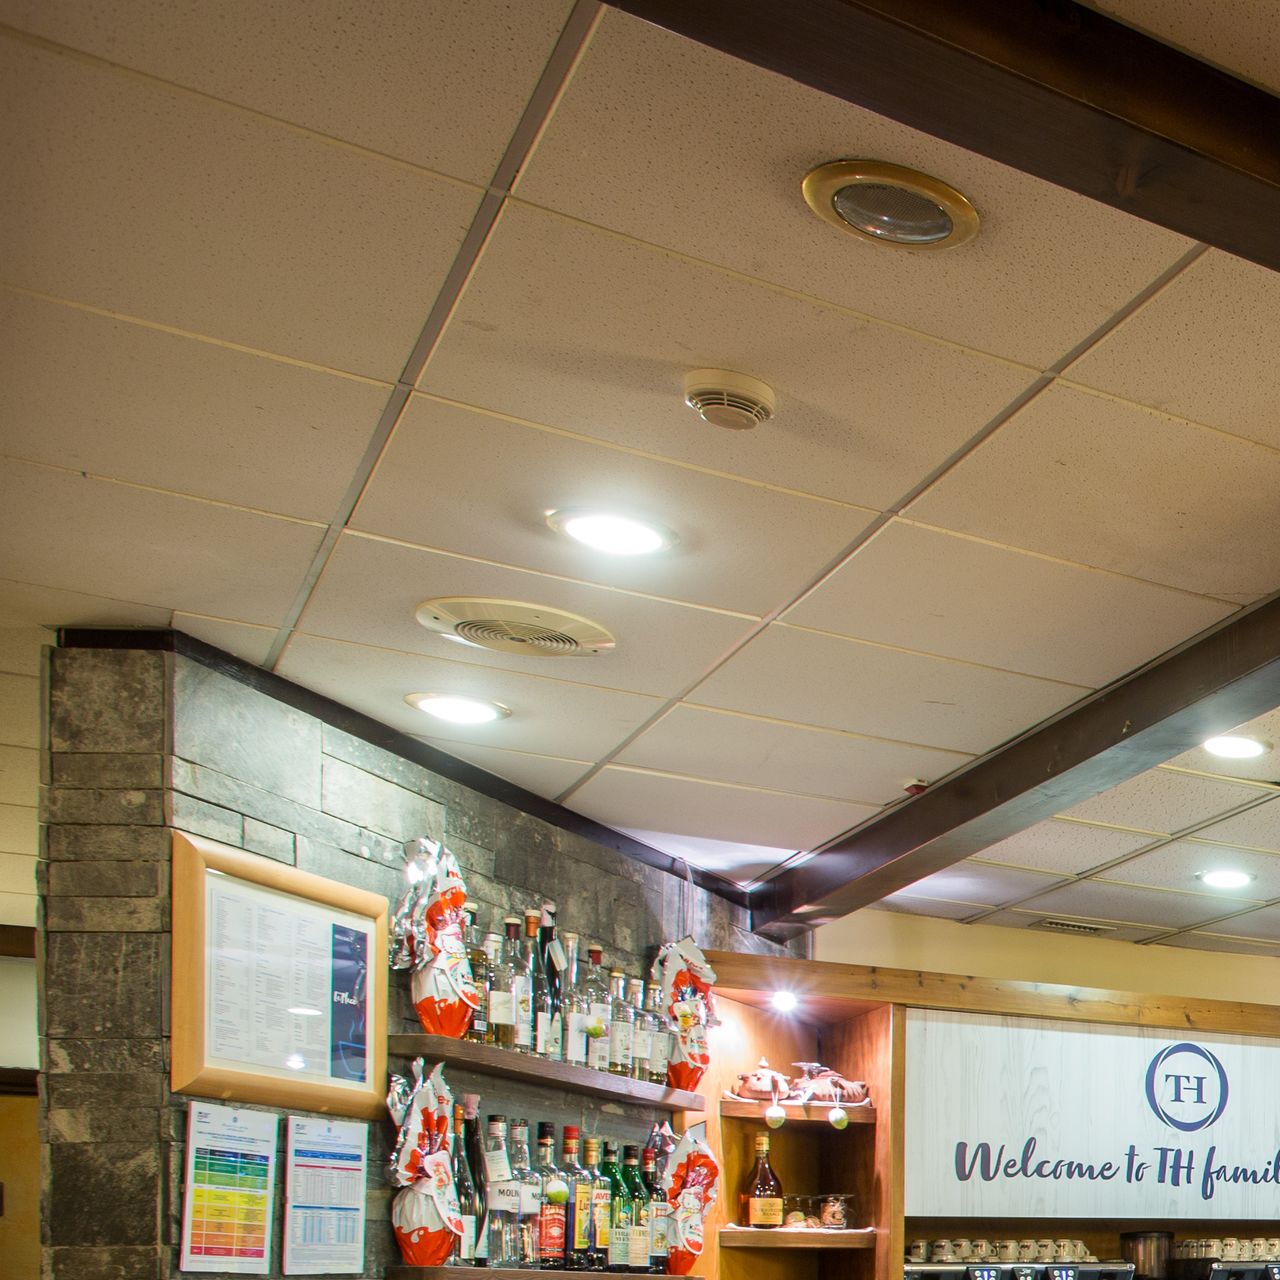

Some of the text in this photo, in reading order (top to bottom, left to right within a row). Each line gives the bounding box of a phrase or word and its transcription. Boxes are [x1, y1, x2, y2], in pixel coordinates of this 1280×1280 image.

[1165, 1074, 1208, 1105] TH
[955, 1136, 1120, 1182] Welcome
[1125, 1144, 1152, 1184] to
[1153, 1145, 1195, 1187] TH
